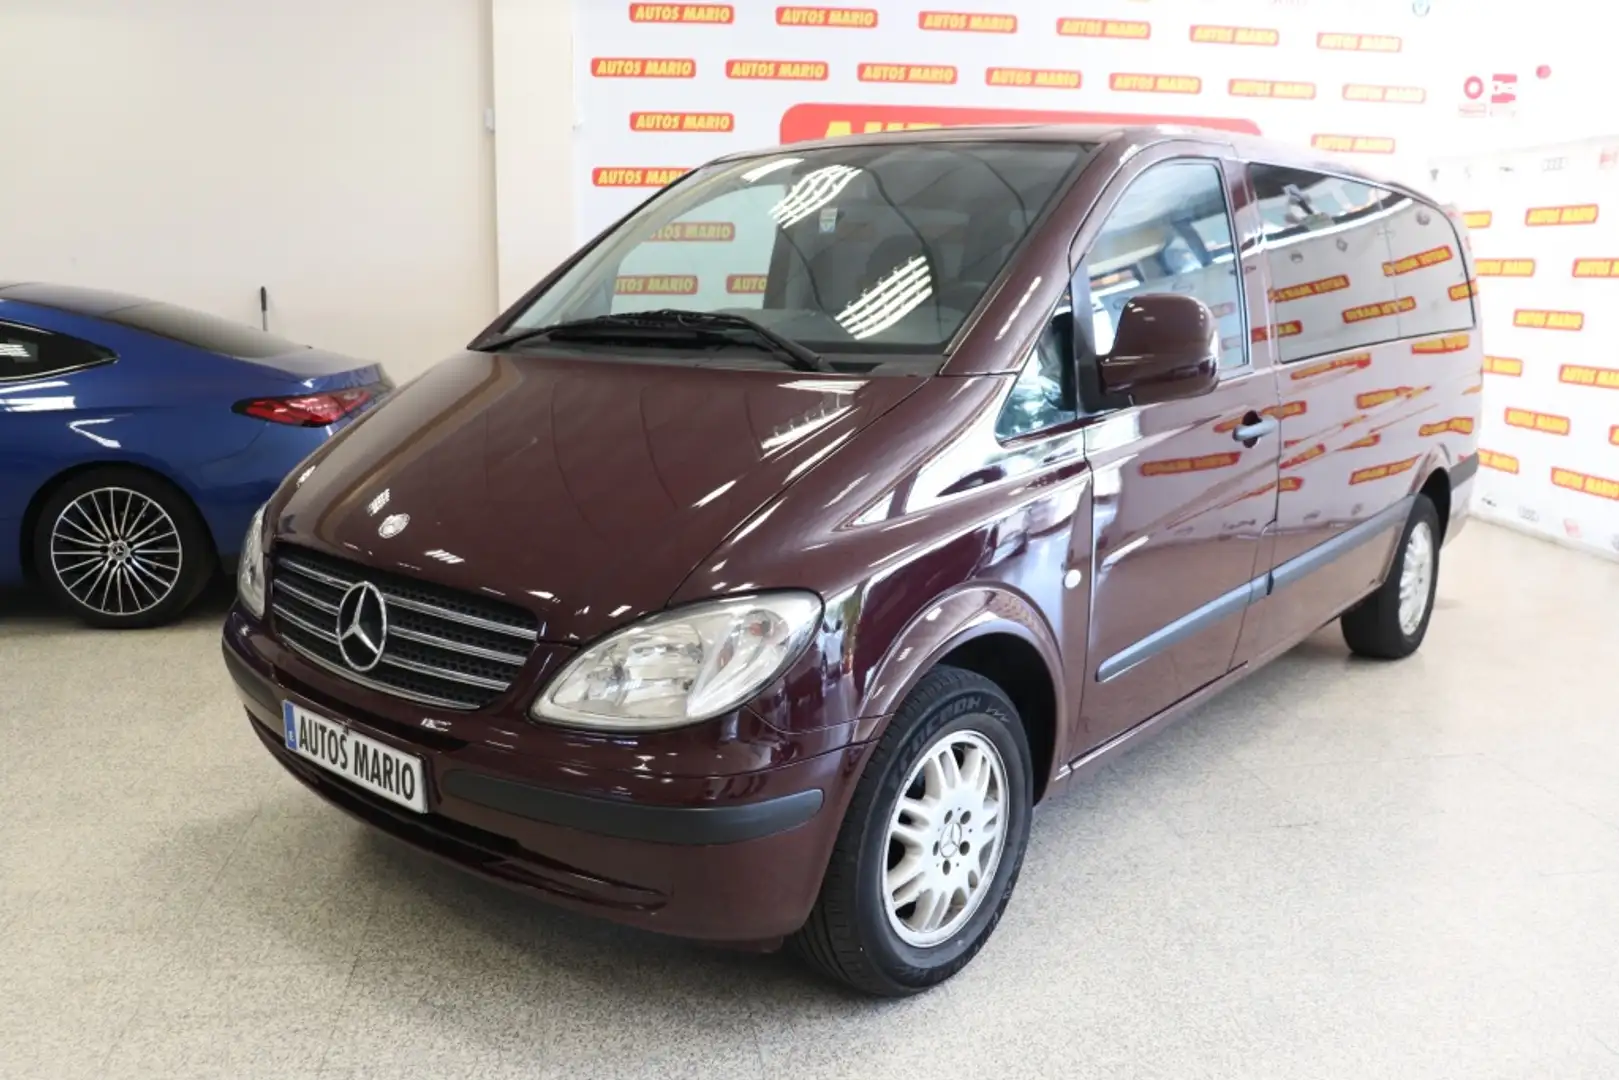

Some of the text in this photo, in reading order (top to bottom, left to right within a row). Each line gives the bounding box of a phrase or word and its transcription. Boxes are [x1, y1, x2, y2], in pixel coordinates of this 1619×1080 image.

[635, 6, 730, 23] AUTOS MARIO
[780, 9, 874, 26] AUTOS MARIO
[924, 14, 1014, 31] AUTOS MARIO
[1061, 20, 1148, 37] AUTOS MARIO
[597, 60, 692, 76] AUTOS MARIO
[731, 62, 825, 79] AUTOS MARIO
[862, 66, 954, 82] AUTOS MARIO
[991, 70, 1079, 87] AUTOS MARIO
[1114, 76, 1198, 92] AUTOS MARIO
[636, 115, 730, 131] AUTOS MARIO
[598, 171, 686, 184] AUTOS MAR
[651, 225, 731, 239] TOS MARIO
[615, 278, 694, 292] TOS MARIO
[732, 278, 767, 291] AUTO
[299, 716, 415, 801] AUTOS MARIO
